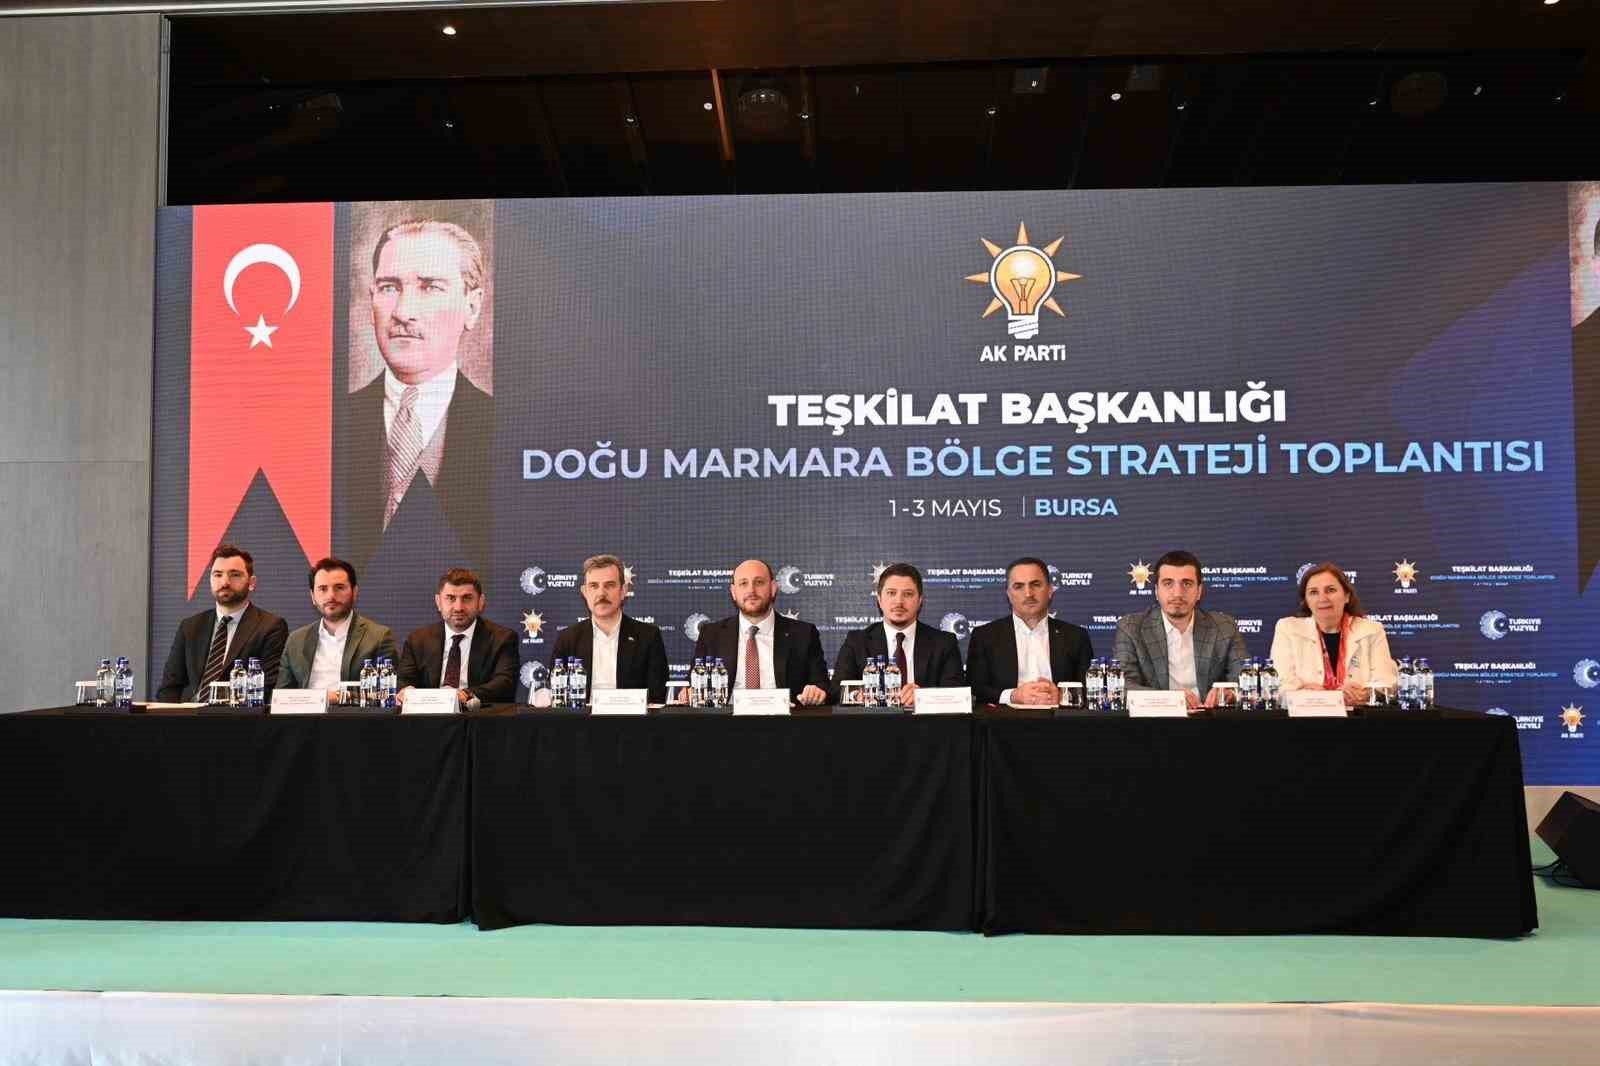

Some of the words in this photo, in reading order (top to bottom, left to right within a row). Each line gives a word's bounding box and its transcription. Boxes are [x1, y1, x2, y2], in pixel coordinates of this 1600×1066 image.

[980, 345, 1007, 361] AK
[768, 388, 987, 435] TEŞKİLAT
[1002, 381, 1286, 433] BAŞKANLIĞI
[523, 441, 648, 480] DOĞU
[664, 447, 893, 479] MARMARA
[906, 439, 1053, 477] BÖLGE
[1066, 434, 1267, 476] STRATEJİ
[1280, 441, 1544, 474] TOPLANTISI
[932, 499, 1002, 517] MAYIS
[1035, 498, 1119, 516] BURSA
